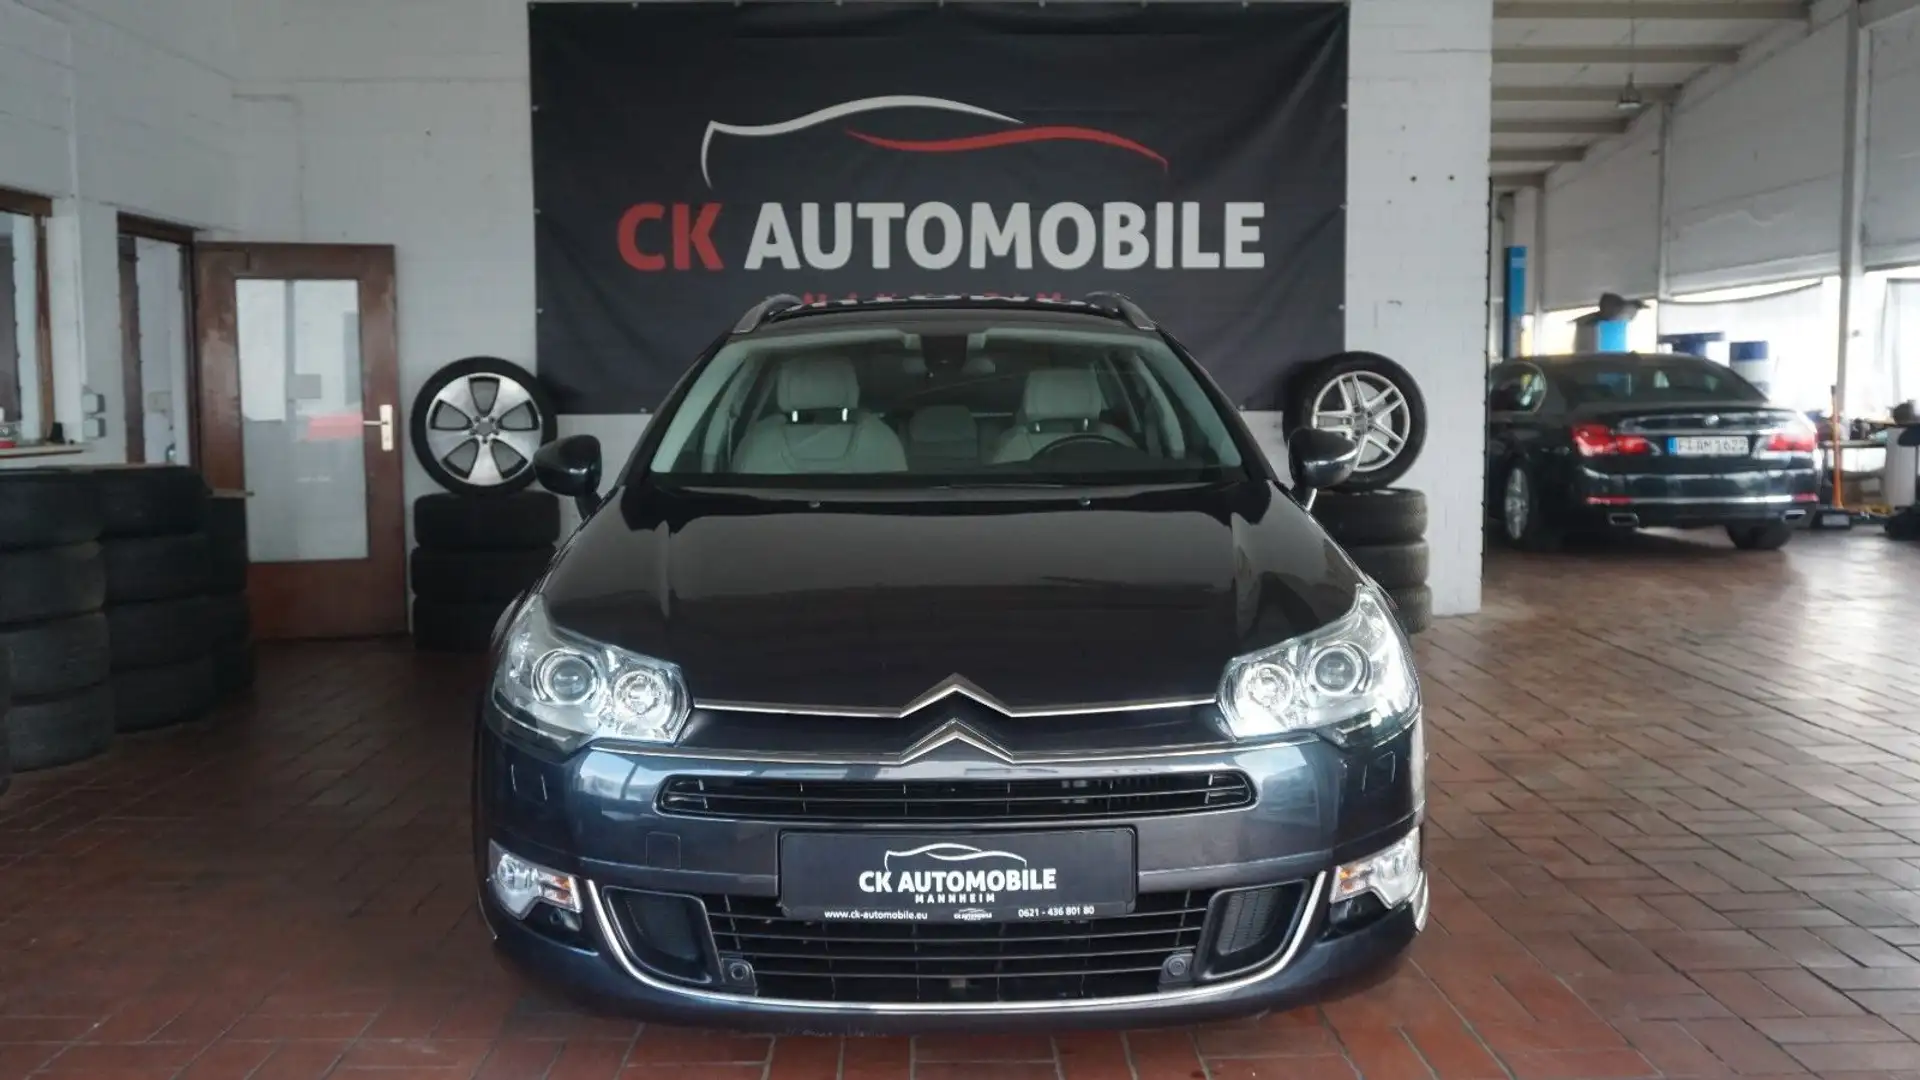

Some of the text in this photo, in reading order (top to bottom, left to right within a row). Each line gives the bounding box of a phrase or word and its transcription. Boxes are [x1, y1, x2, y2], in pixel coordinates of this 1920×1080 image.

[616, 201, 1266, 270] CK AUTOMOBILE
[858, 868, 1057, 893] CK AUTOMOBILE
[914, 893, 996, 904] MANNHEIM
[824, 909, 928, 920] www.ck-automobile.eu
[1018, 908, 1039, 918] 0621
[1047, 906, 1064, 917] 436
[1065, 906, 1080, 916] 801
[1083, 905, 1095, 915] 80
